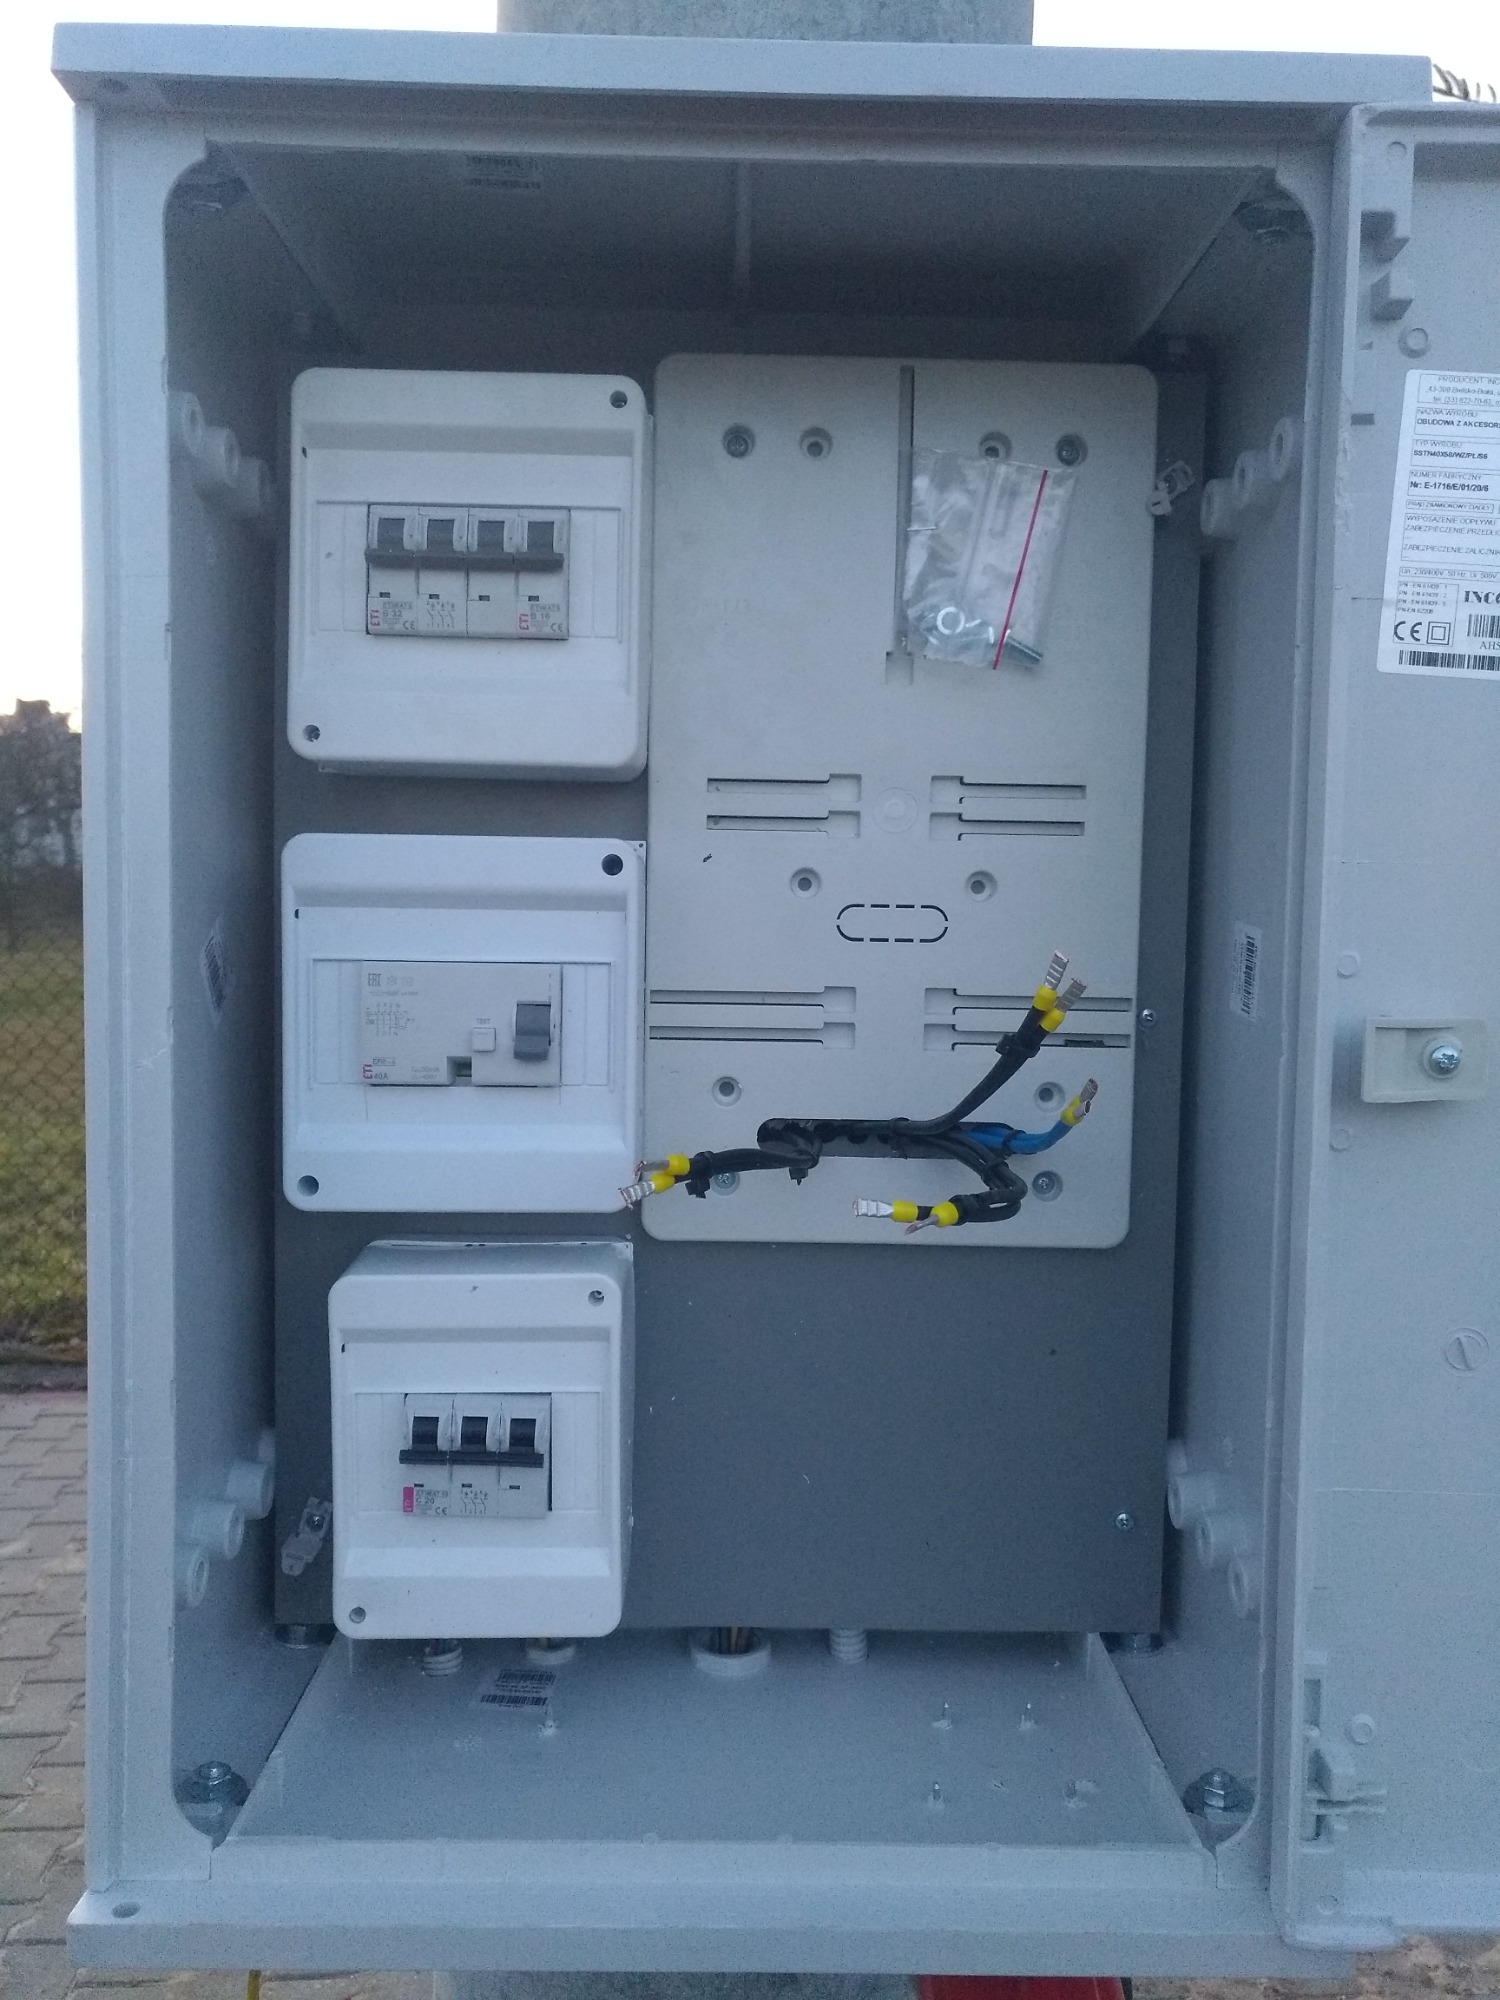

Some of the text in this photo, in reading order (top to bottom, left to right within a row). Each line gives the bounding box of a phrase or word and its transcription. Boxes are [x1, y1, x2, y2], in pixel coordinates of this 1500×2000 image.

[1417, 418, 1454, 426] OBUDOWA
[1430, 440, 1462, 448] WYROBU
[1410, 470, 1482, 480] NUMER FABRYCZNY
[1410, 480, 1422, 488] Nr:
[1405, 524, 1466, 534] ZABEZPIECZENIE
[1403, 544, 1464, 554] ZABEZPIECZENIE
